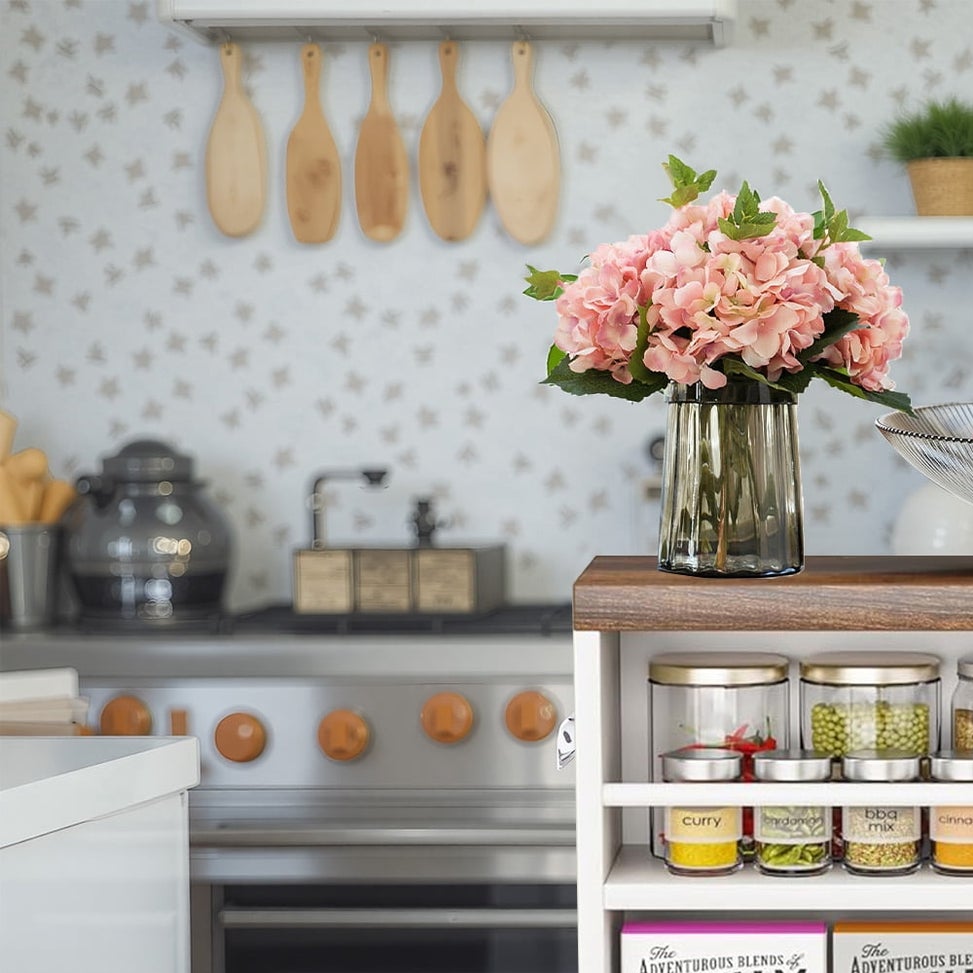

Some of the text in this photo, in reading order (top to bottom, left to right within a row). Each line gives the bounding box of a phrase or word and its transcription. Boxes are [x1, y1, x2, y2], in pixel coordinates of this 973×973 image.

[865, 808, 897, 821] bbq
[682, 816, 722, 828] curry
[868, 820, 895, 832] mix
[650, 945, 677, 960] The
[861, 943, 889, 958] The
[737, 954, 785, 968] BLENDS
[786, 953, 805, 970] of
